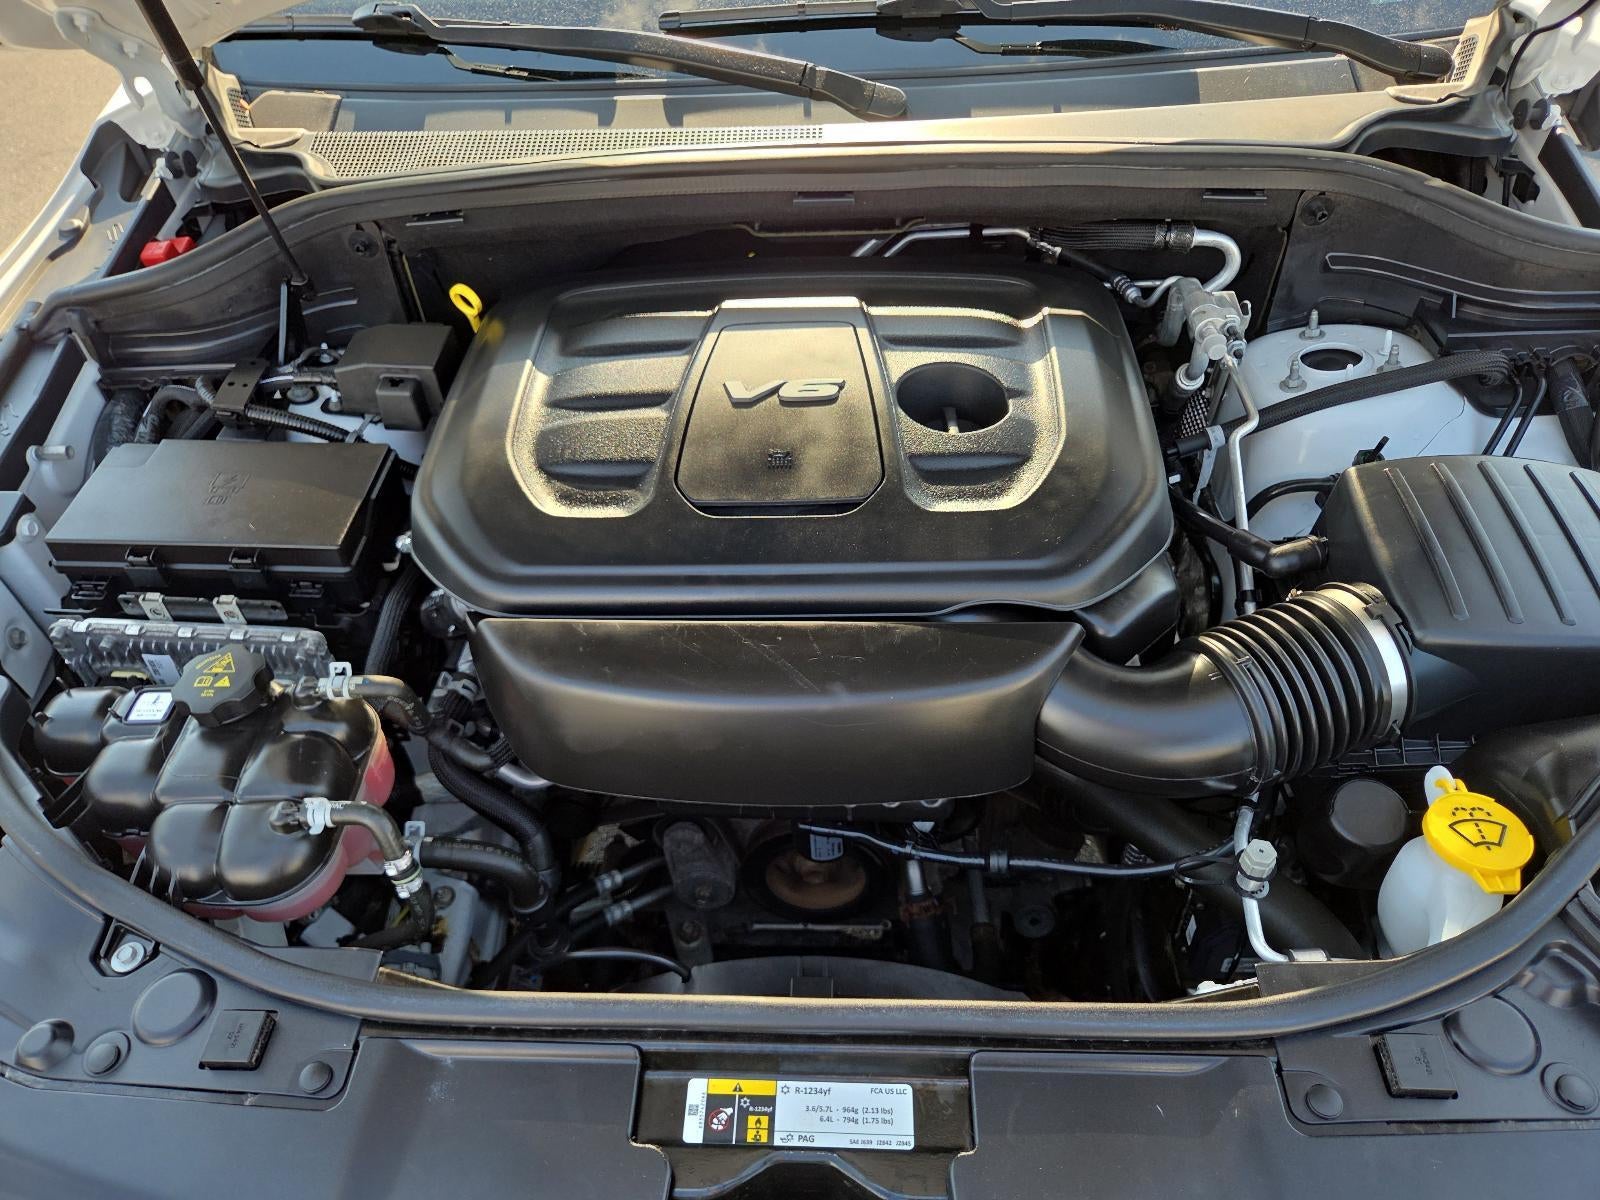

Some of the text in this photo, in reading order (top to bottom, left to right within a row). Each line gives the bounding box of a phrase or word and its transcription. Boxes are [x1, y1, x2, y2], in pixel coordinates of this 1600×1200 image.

[723, 378, 846, 407] V6
[794, 1087, 832, 1096] R-1234yf
[805, 1105, 833, 1113] 3.6/5.7L
[842, 1106, 859, 1115] 964g
[862, 1107, 879, 1115] (2.13
[880, 1107, 893, 1116] lbs)
[842, 1117, 859, 1125] 794g
[862, 1117, 880, 1125] (1.75
[880, 1117, 894, 1125] lbs)
[797, 1135, 815, 1143] PAG
